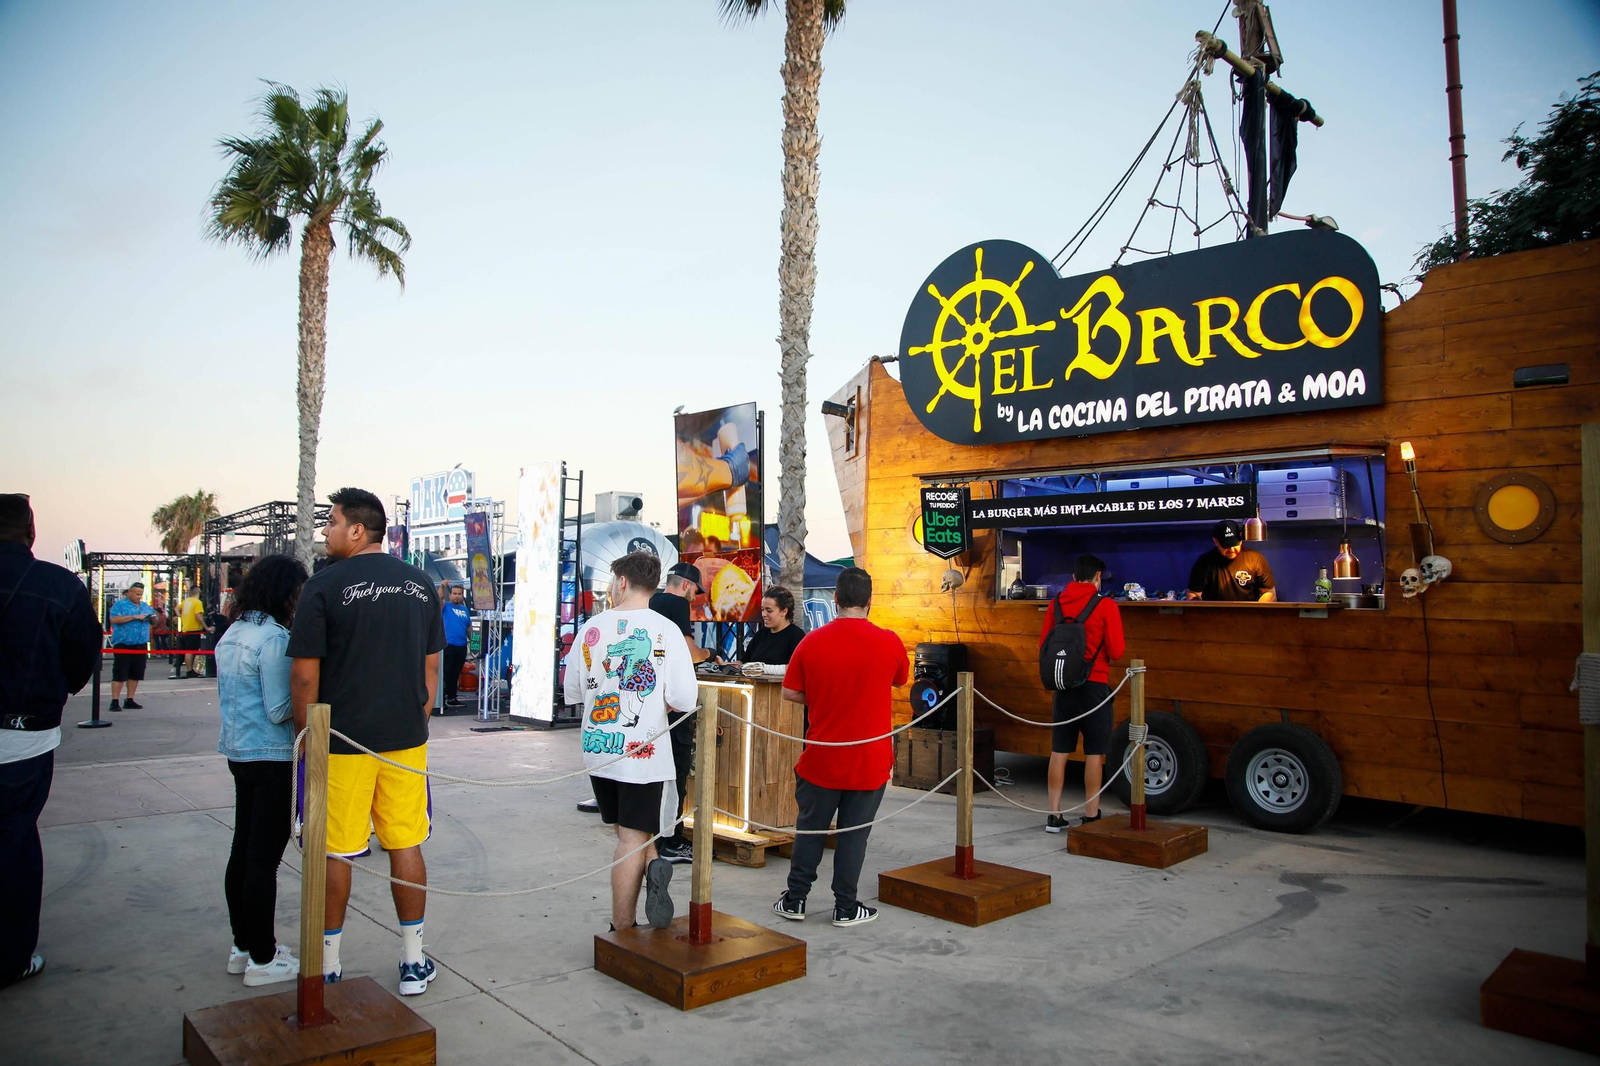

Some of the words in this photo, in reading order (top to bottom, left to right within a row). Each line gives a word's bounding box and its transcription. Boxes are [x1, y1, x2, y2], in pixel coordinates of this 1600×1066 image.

[991, 345, 1054, 396] EL
[1060, 275, 1365, 381] BARCO
[997, 402, 1014, 423] by
[1017, 407, 1043, 433] LA
[1048, 396, 1128, 430] COCINA
[1136, 390, 1178, 419] DEL
[1184, 378, 1272, 415] PIRATA
[1278, 382, 1296, 403] &
[1302, 367, 1366, 401] MOA
[925, 492, 958, 501] RECOGE
[972, 510, 986, 519] LA
[987, 507, 1033, 519] BURGER
[1033, 505, 1058, 518] MÁS
[1060, 501, 1136, 516] IMPLACABLE
[1138, 501, 1156, 511] DE
[1158, 498, 1184, 510] LOS
[1186, 498, 1195, 509] 7
[1196, 495, 1245, 510] MARES
[925, 511, 961, 527] Uber
[926, 528, 962, 544] Eats
[342, 581, 375, 606] Fuel
[371, 585, 402, 602] your
[403, 579, 429, 602] Fire
